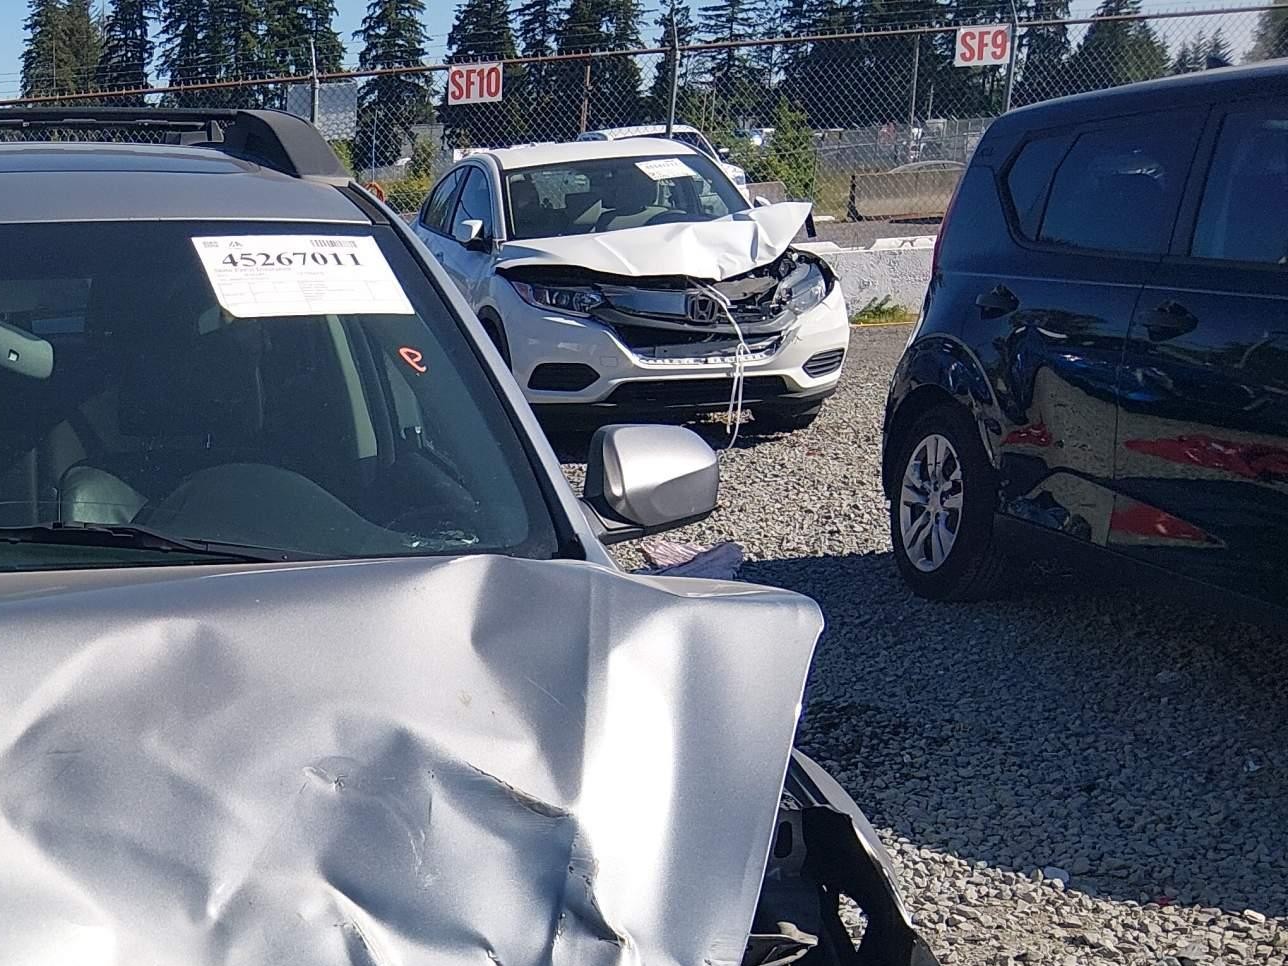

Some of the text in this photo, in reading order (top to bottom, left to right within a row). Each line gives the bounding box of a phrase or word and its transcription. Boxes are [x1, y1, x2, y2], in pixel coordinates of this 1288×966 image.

[960, 29, 1008, 62] SF9
[450, 66, 501, 101] SF10
[222, 252, 364, 268] 45267011
